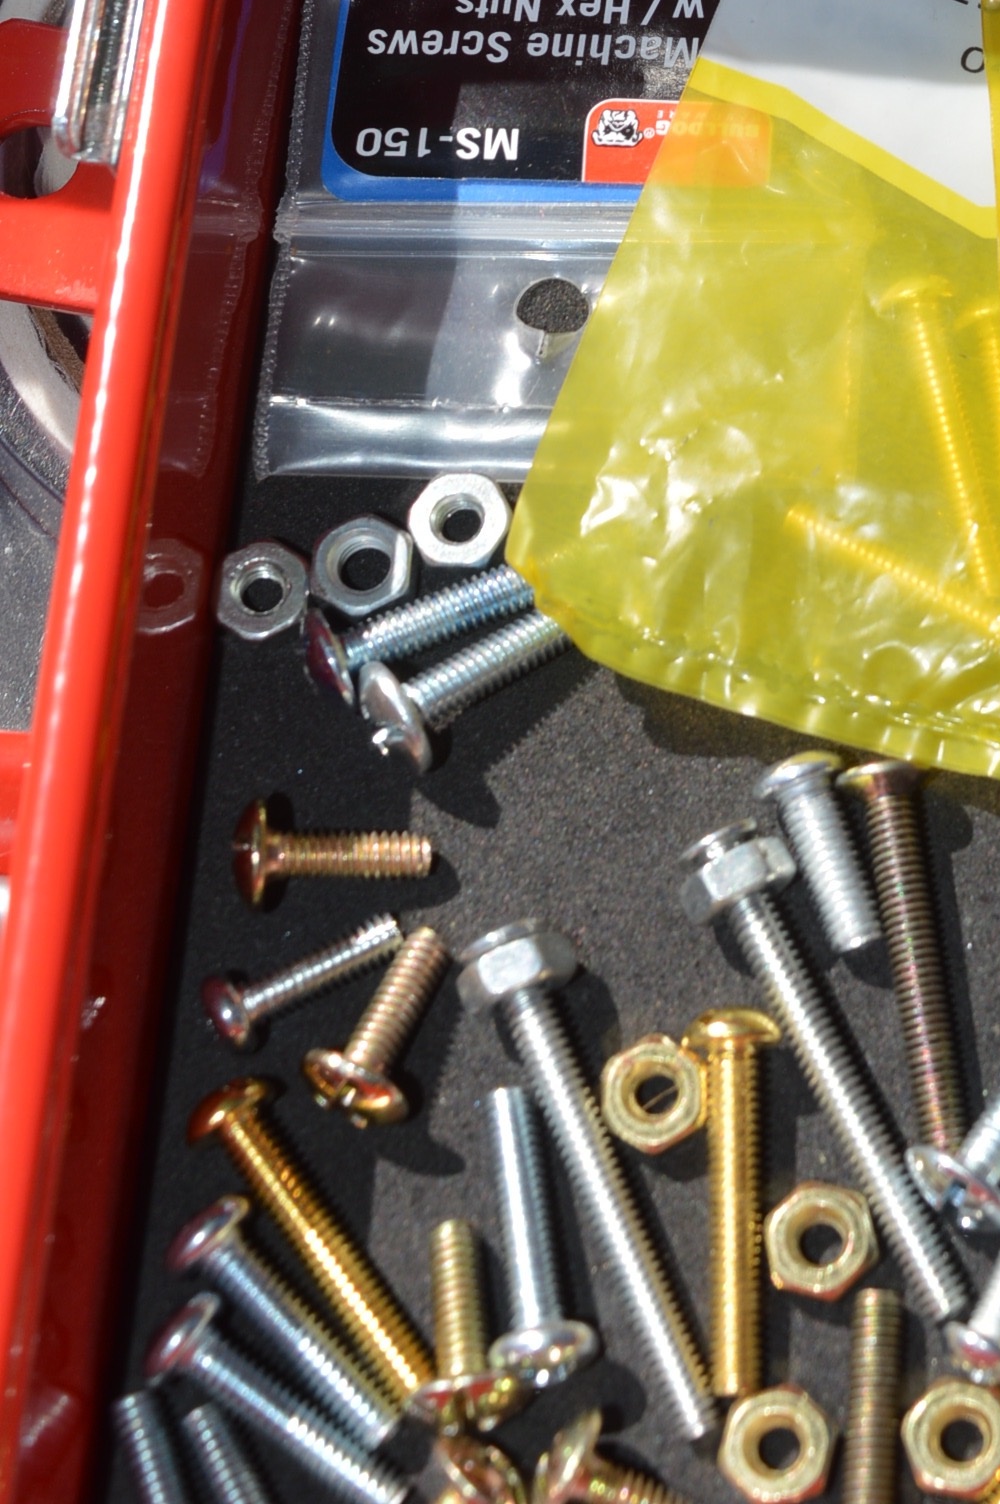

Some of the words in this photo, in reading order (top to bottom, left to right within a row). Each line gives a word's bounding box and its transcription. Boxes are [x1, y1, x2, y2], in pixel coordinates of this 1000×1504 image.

[367, 28, 512, 64] Screws
[527, 32, 700, 68] Machine
[356, 127, 519, 162] MS-150
